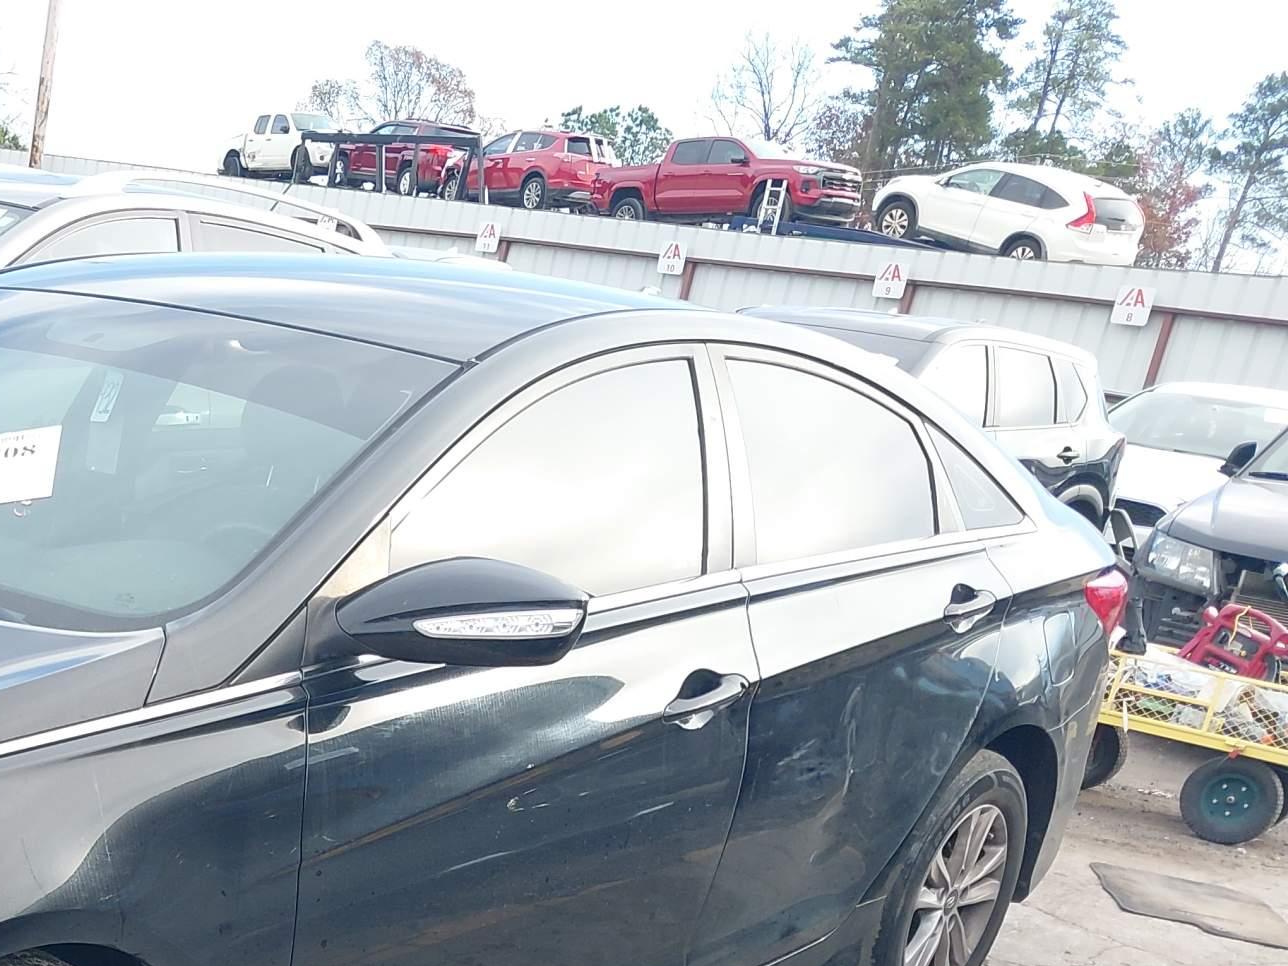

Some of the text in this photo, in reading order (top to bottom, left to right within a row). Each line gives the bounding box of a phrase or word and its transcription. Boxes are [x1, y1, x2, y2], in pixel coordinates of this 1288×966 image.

[665, 264, 675, 273] 10
[885, 286, 891, 296] 9
[1126, 312, 1133, 322] 8
